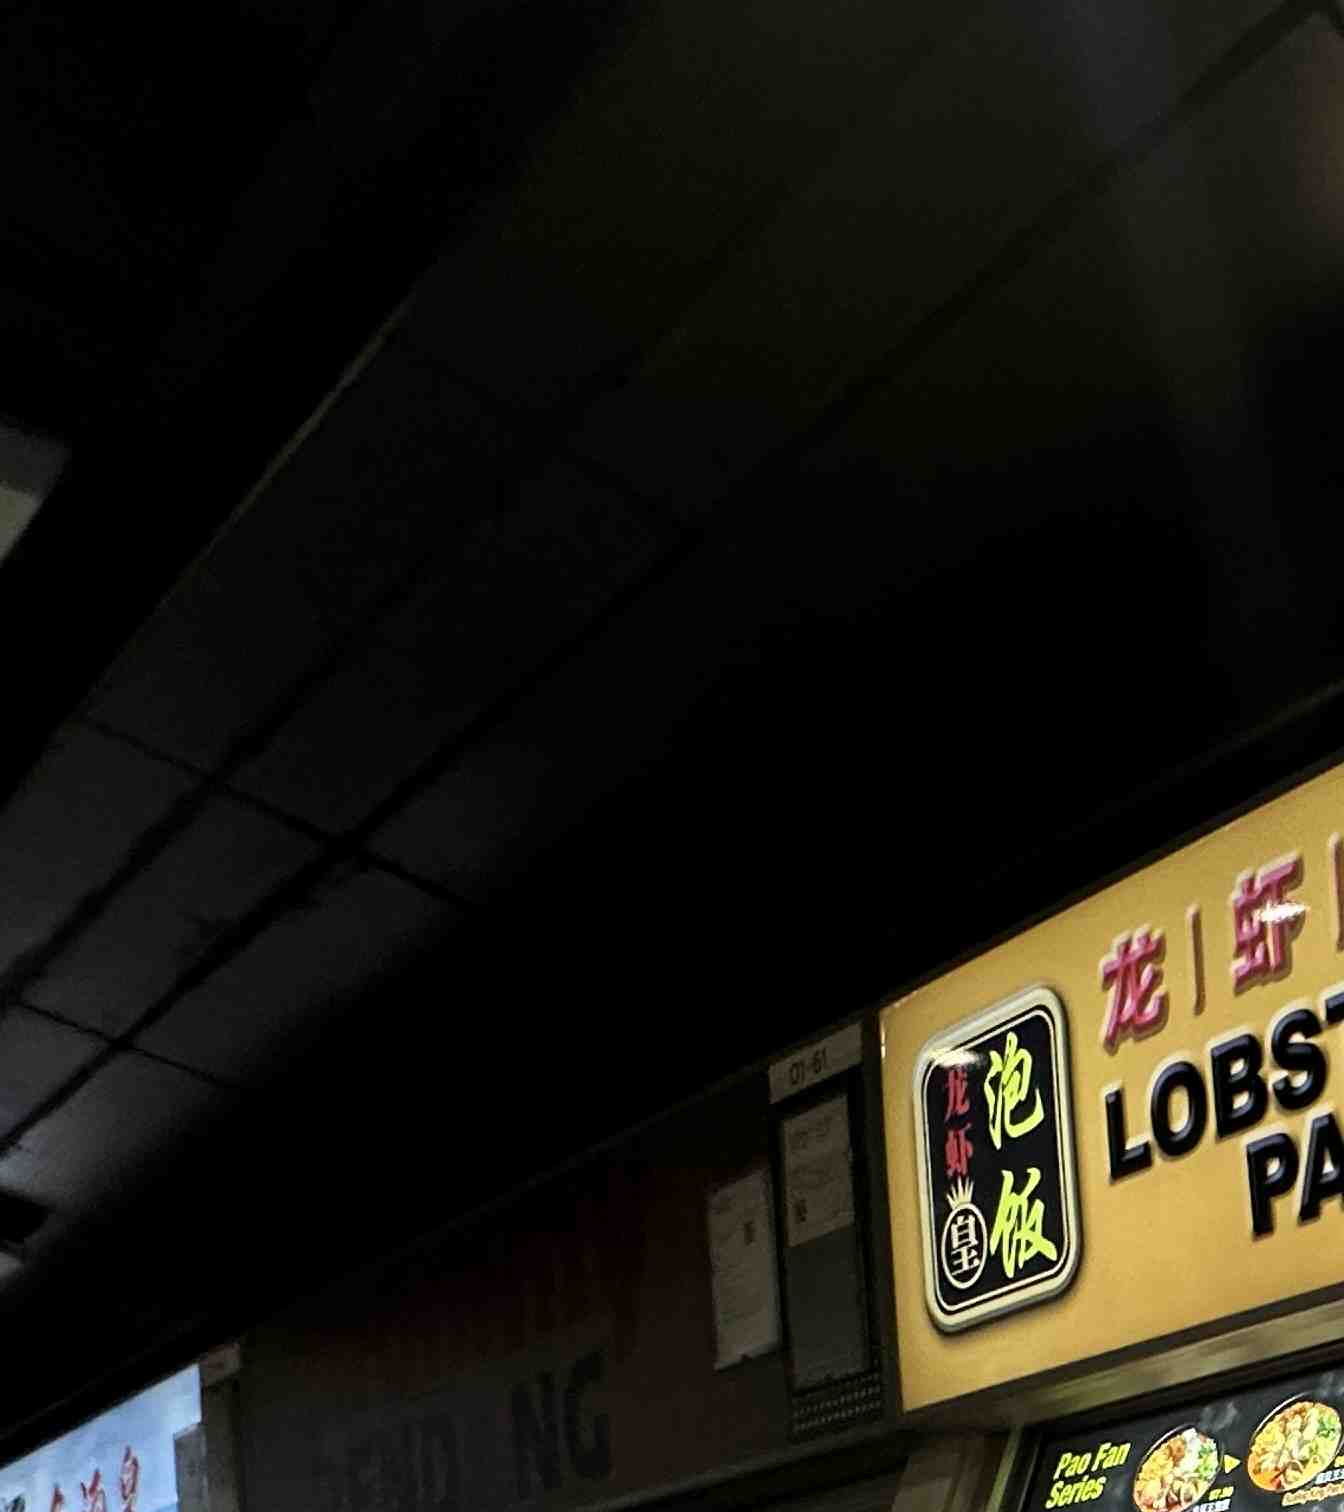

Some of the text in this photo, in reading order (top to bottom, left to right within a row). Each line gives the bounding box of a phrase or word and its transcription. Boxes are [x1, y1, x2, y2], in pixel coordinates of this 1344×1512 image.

[1053, 1441, 1131, 1480] Pao Fan
[1045, 1475, 1106, 1510] Series
